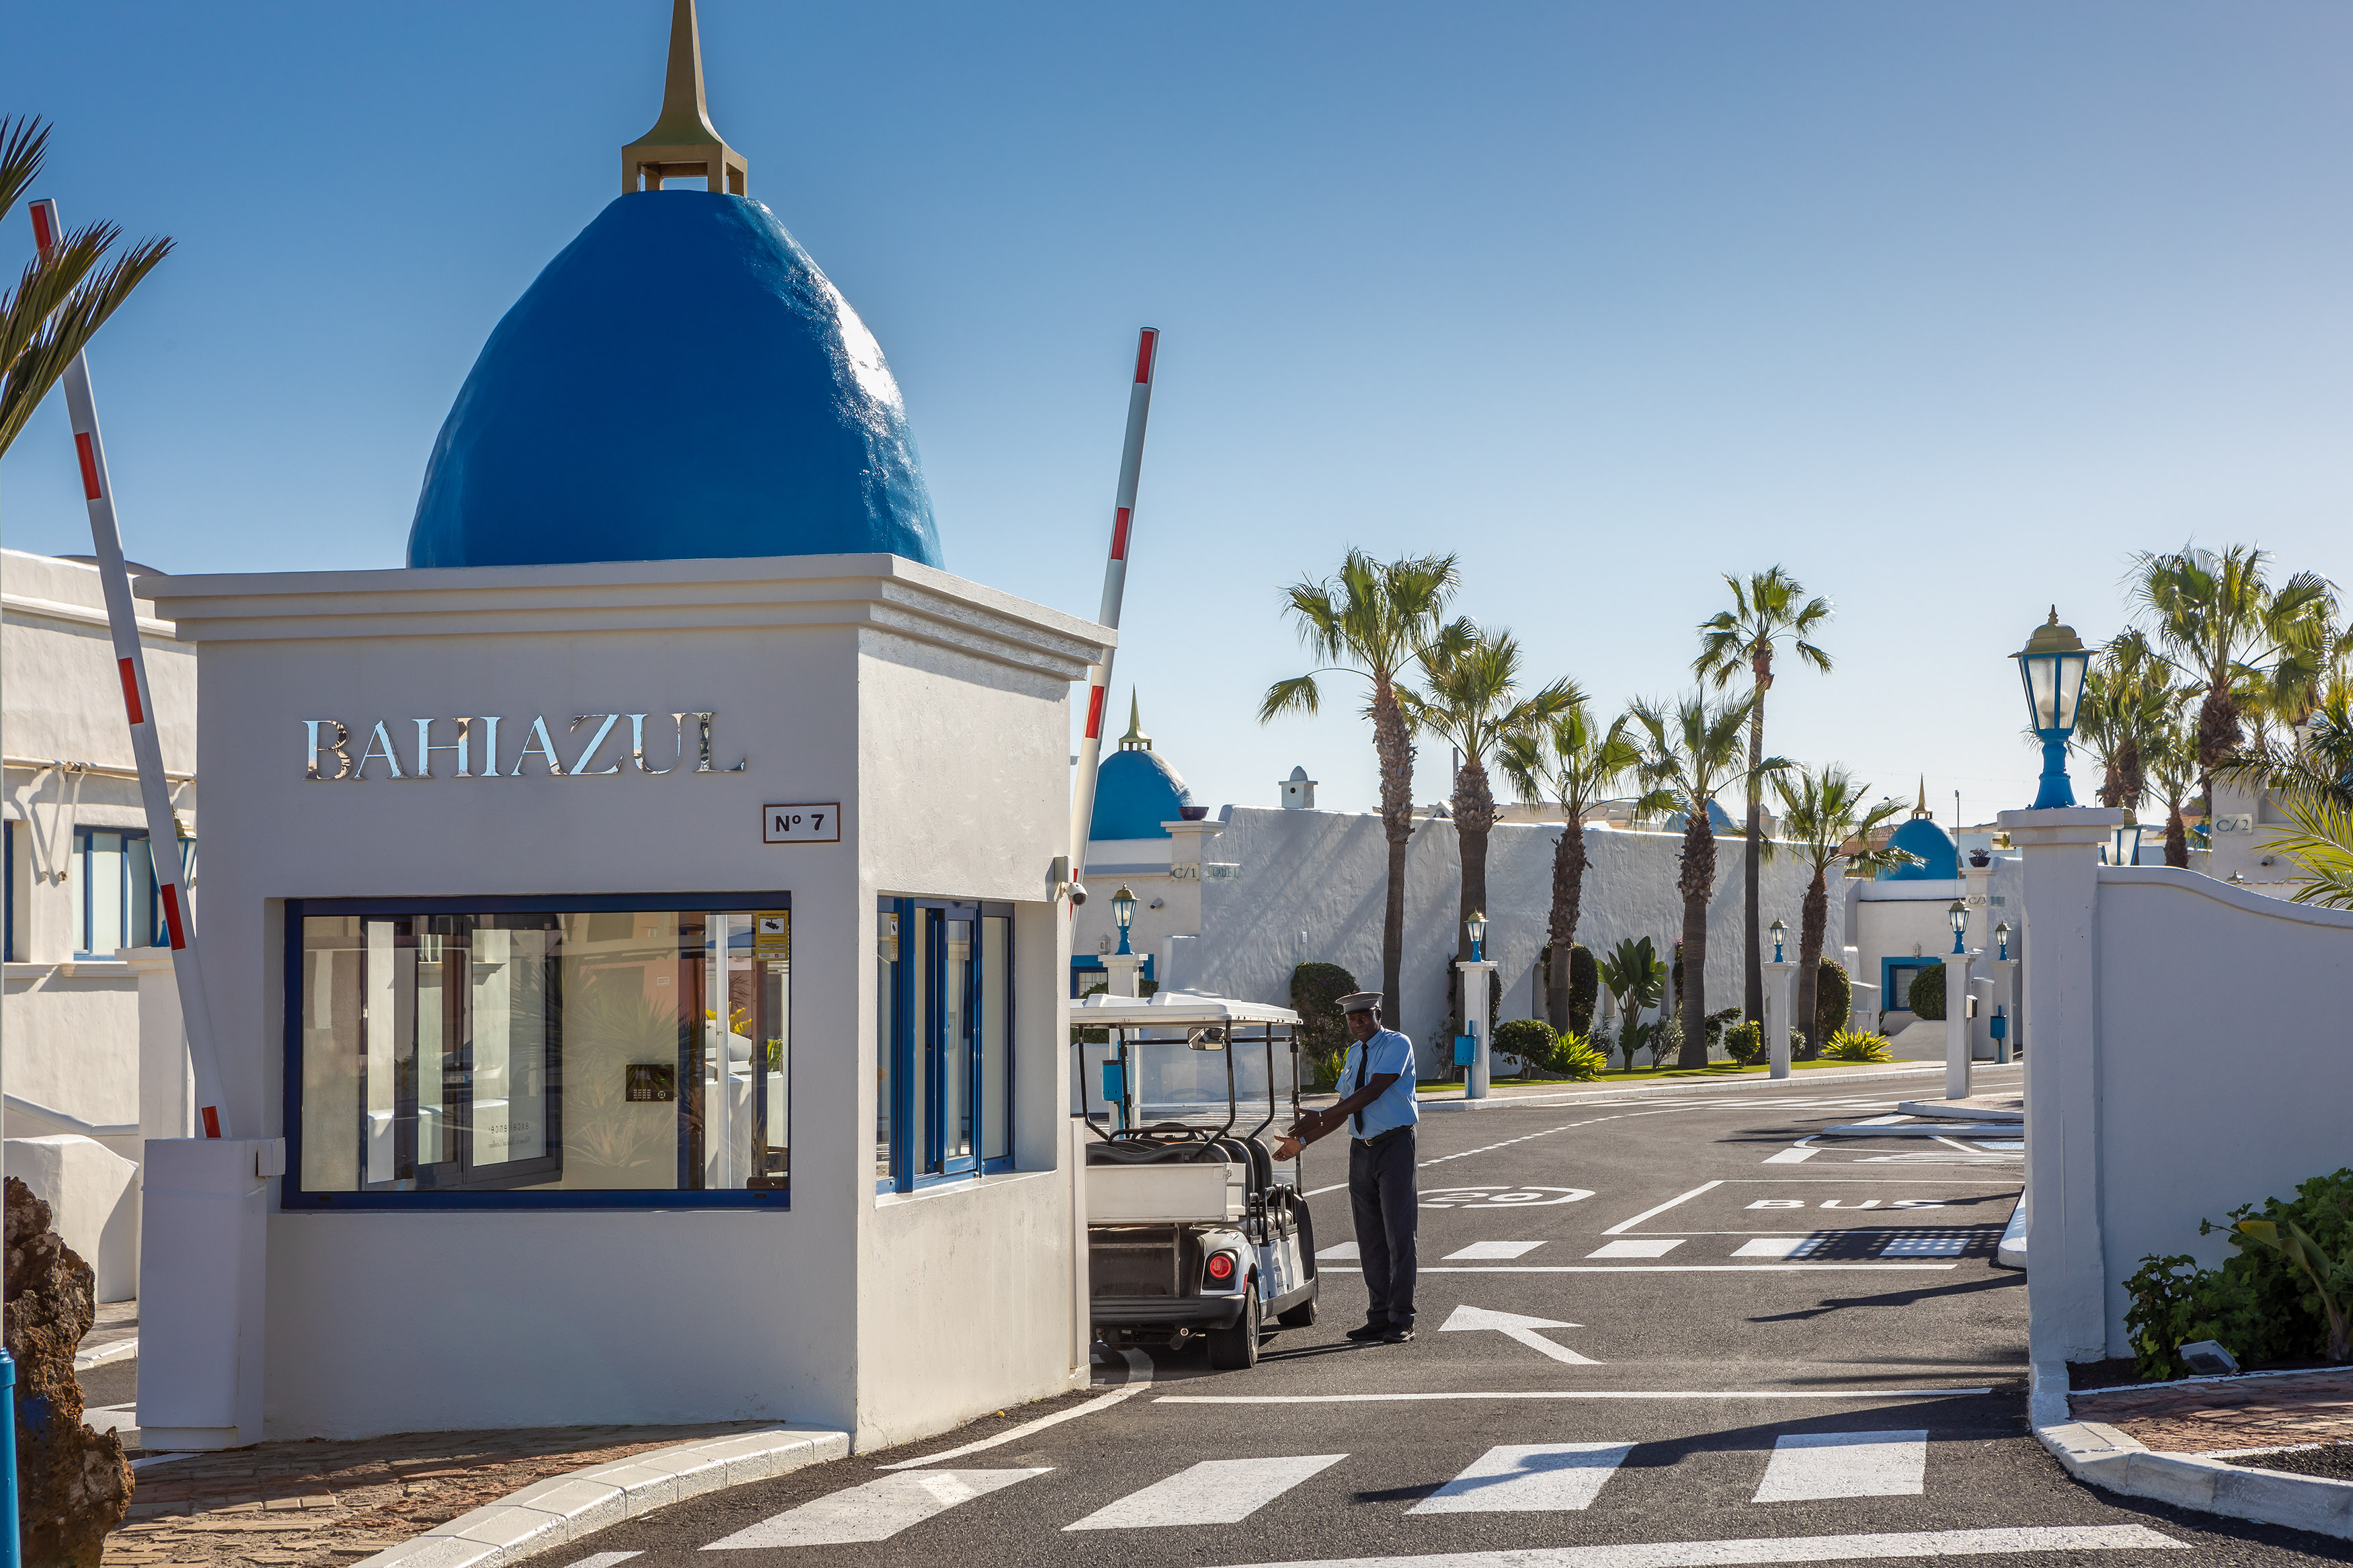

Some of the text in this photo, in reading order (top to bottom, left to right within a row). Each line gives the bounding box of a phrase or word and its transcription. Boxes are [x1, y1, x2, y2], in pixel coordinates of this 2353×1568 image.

[302, 712, 746, 780] BAHIAZUL
[775, 814, 824, 832] Nº 7
[1172, 866, 1196, 878] C/1
[1212, 866, 1232, 877] CALLE
[1425, 1192, 1544, 1202] 20
[1743, 1200, 1945, 1209] BUS
